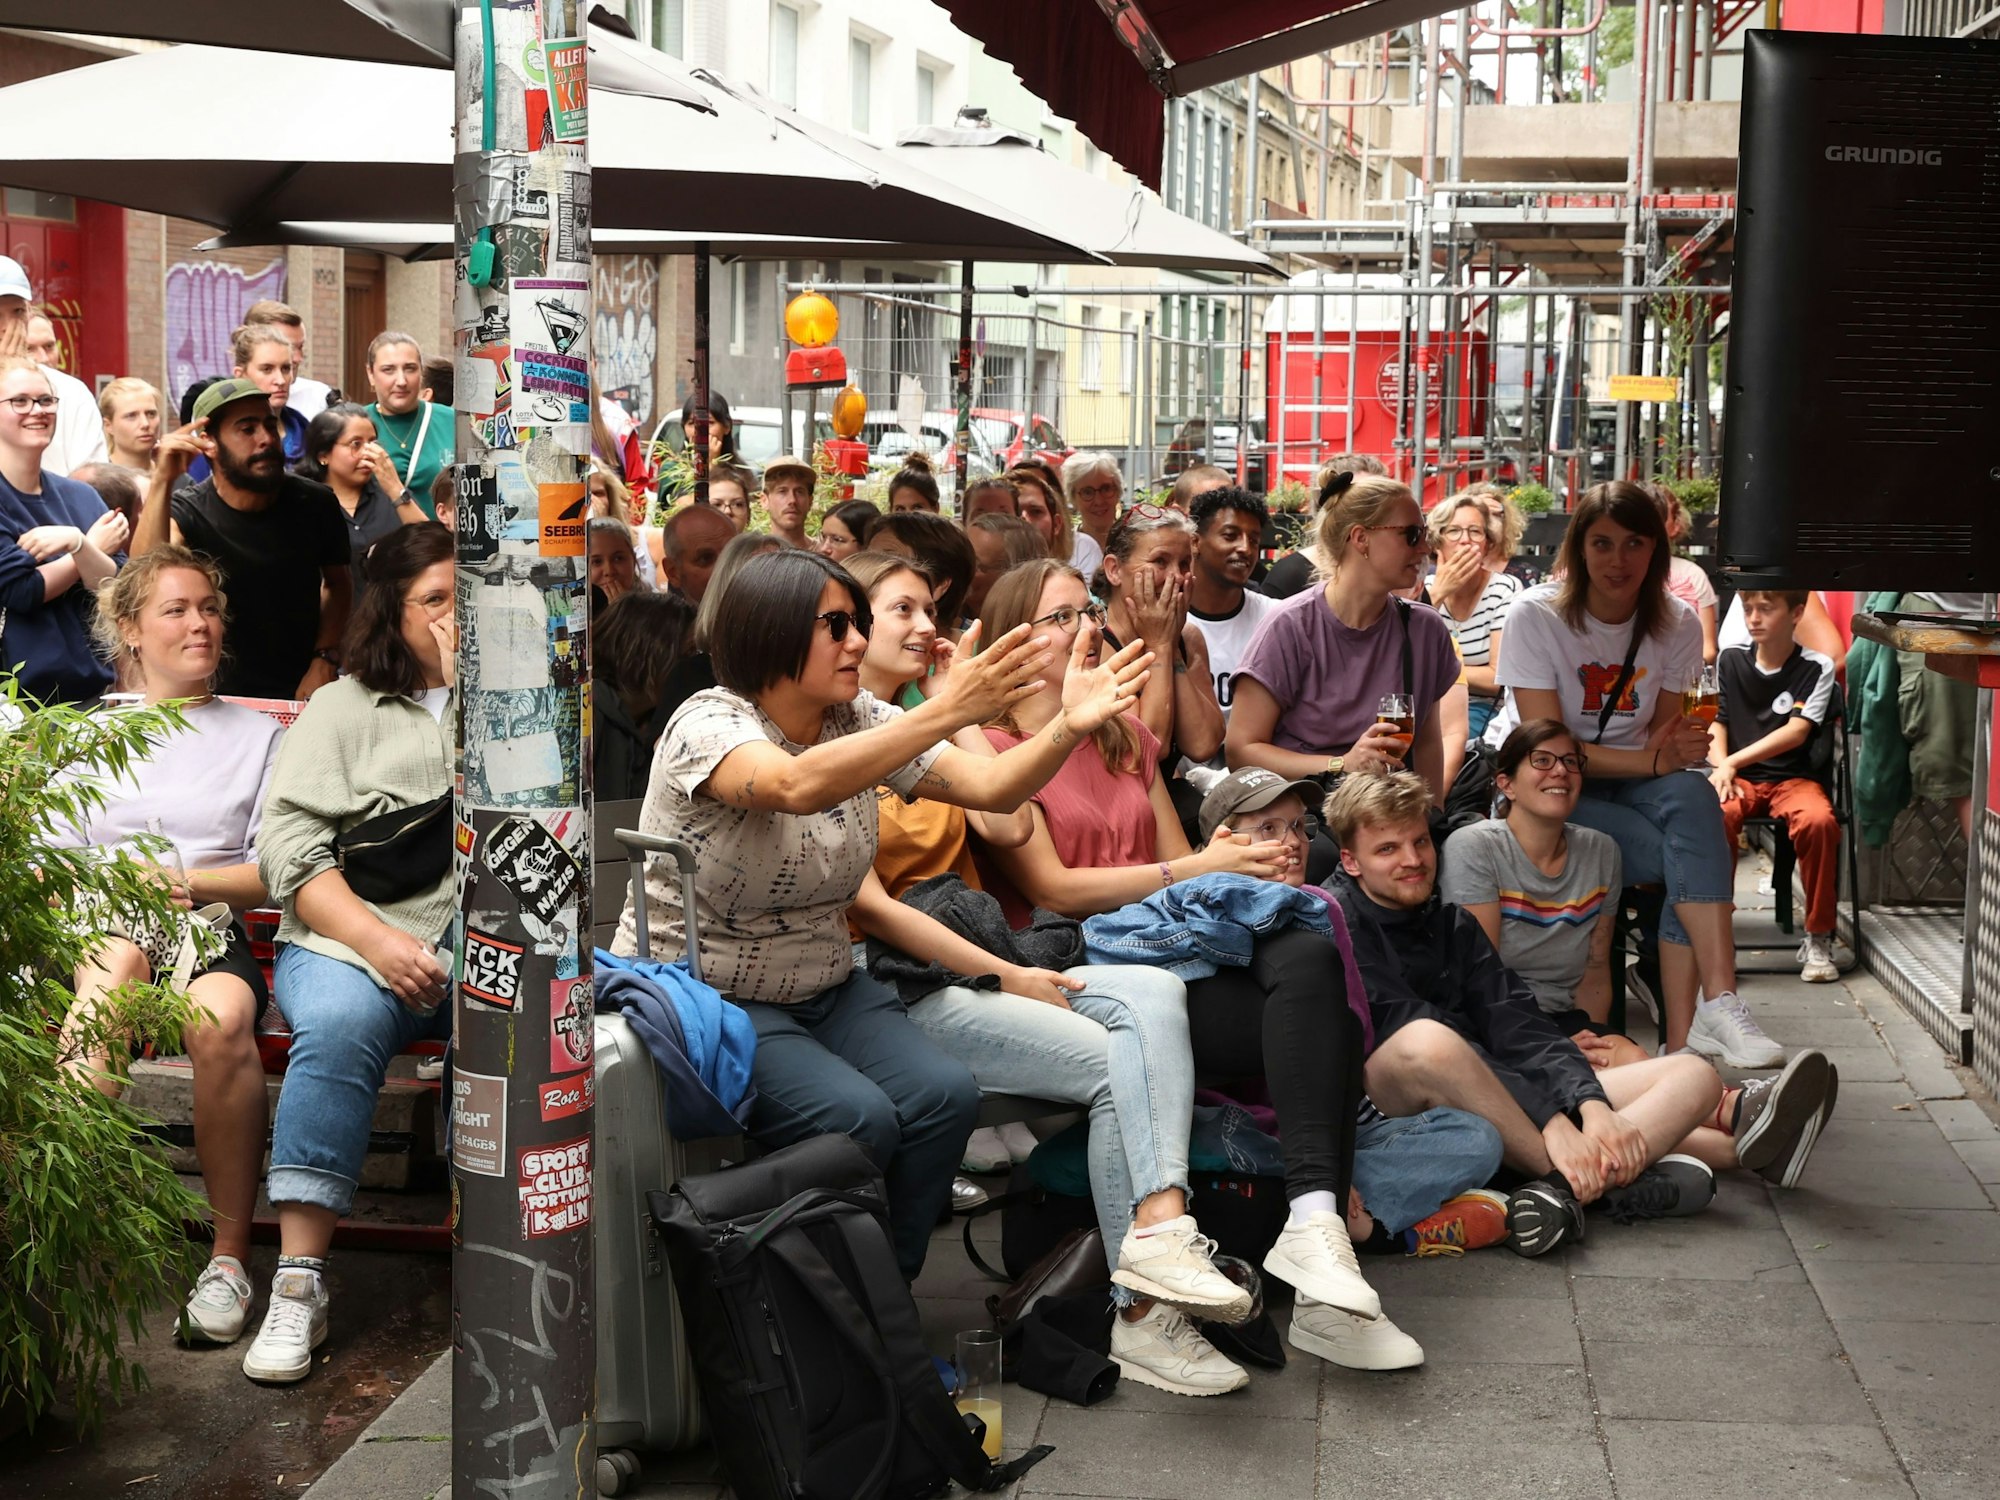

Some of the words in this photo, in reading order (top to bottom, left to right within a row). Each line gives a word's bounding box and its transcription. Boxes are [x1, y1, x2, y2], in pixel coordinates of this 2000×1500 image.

[555, 80, 587, 113] KA
[1825, 145, 1943, 166] GRUNDIG
[489, 821, 536, 870] GEGEN
[536, 864, 576, 916] NAZIS
[465, 937, 522, 977] FCK
[462, 960, 515, 999] NZS
[544, 1089, 580, 1111] Rote
[462, 1134, 497, 1152] FACES
[525, 1143, 588, 1176] SPORT
[535, 1166, 585, 1193] CLUB
[527, 1183, 590, 1210] FORTUNA
